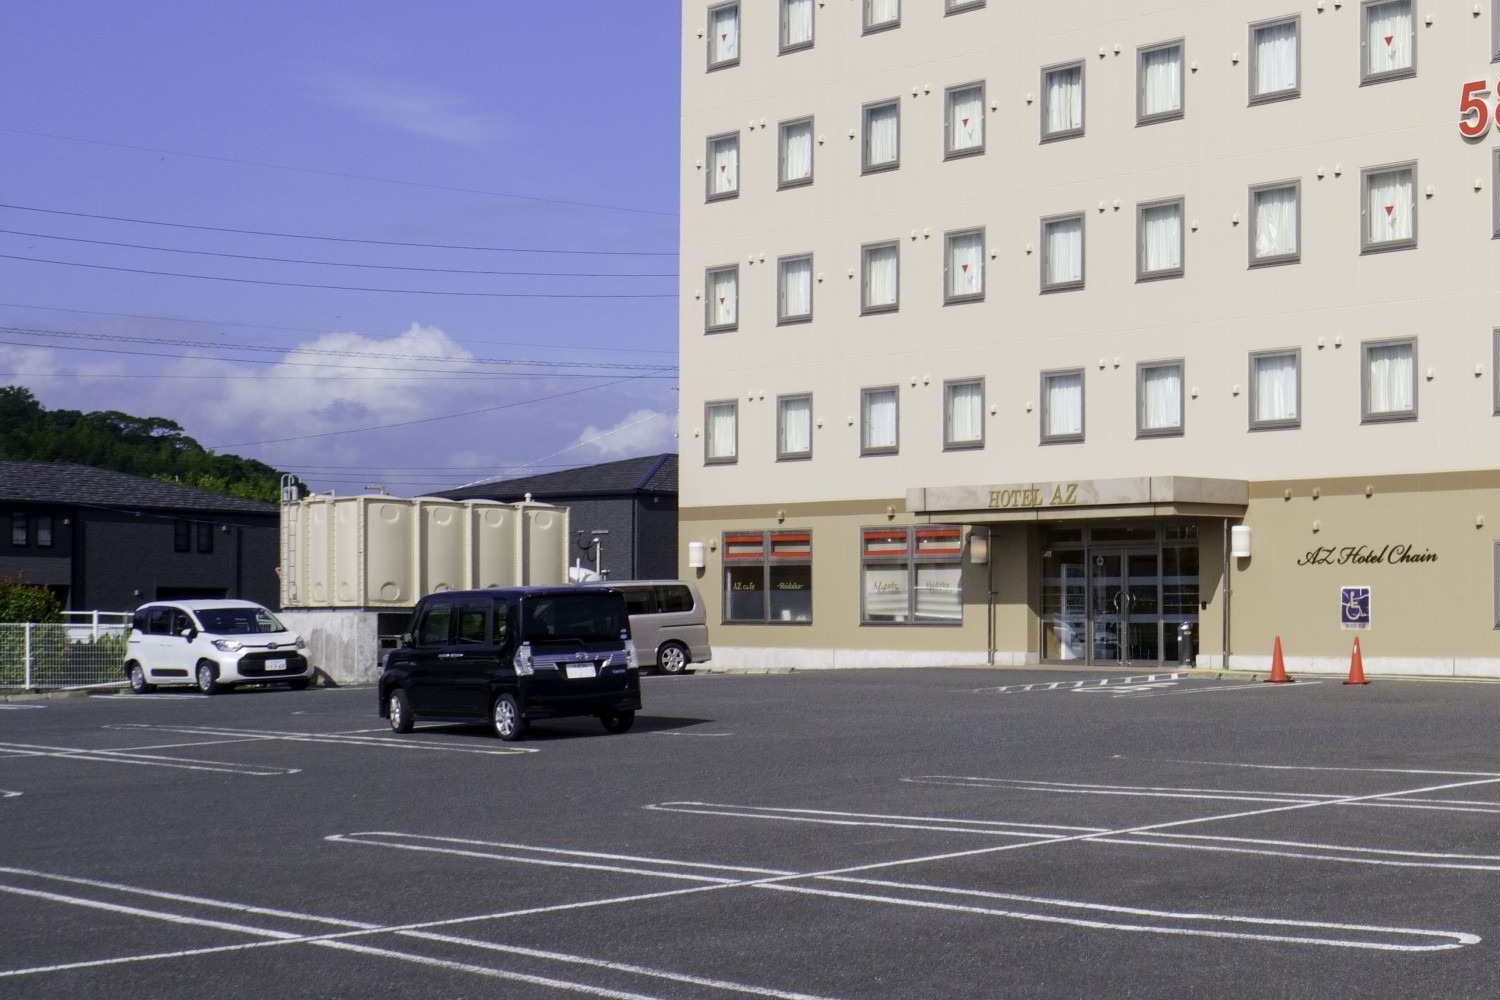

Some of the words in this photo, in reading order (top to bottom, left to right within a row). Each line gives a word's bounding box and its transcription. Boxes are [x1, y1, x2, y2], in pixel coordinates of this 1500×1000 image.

[988, 489, 1042, 507] HOTEL
[1049, 483, 1078, 505] AZ
[1297, 546, 1337, 566] AZ
[1337, 544, 1389, 565] Hotel
[1387, 544, 1439, 564] Chain
